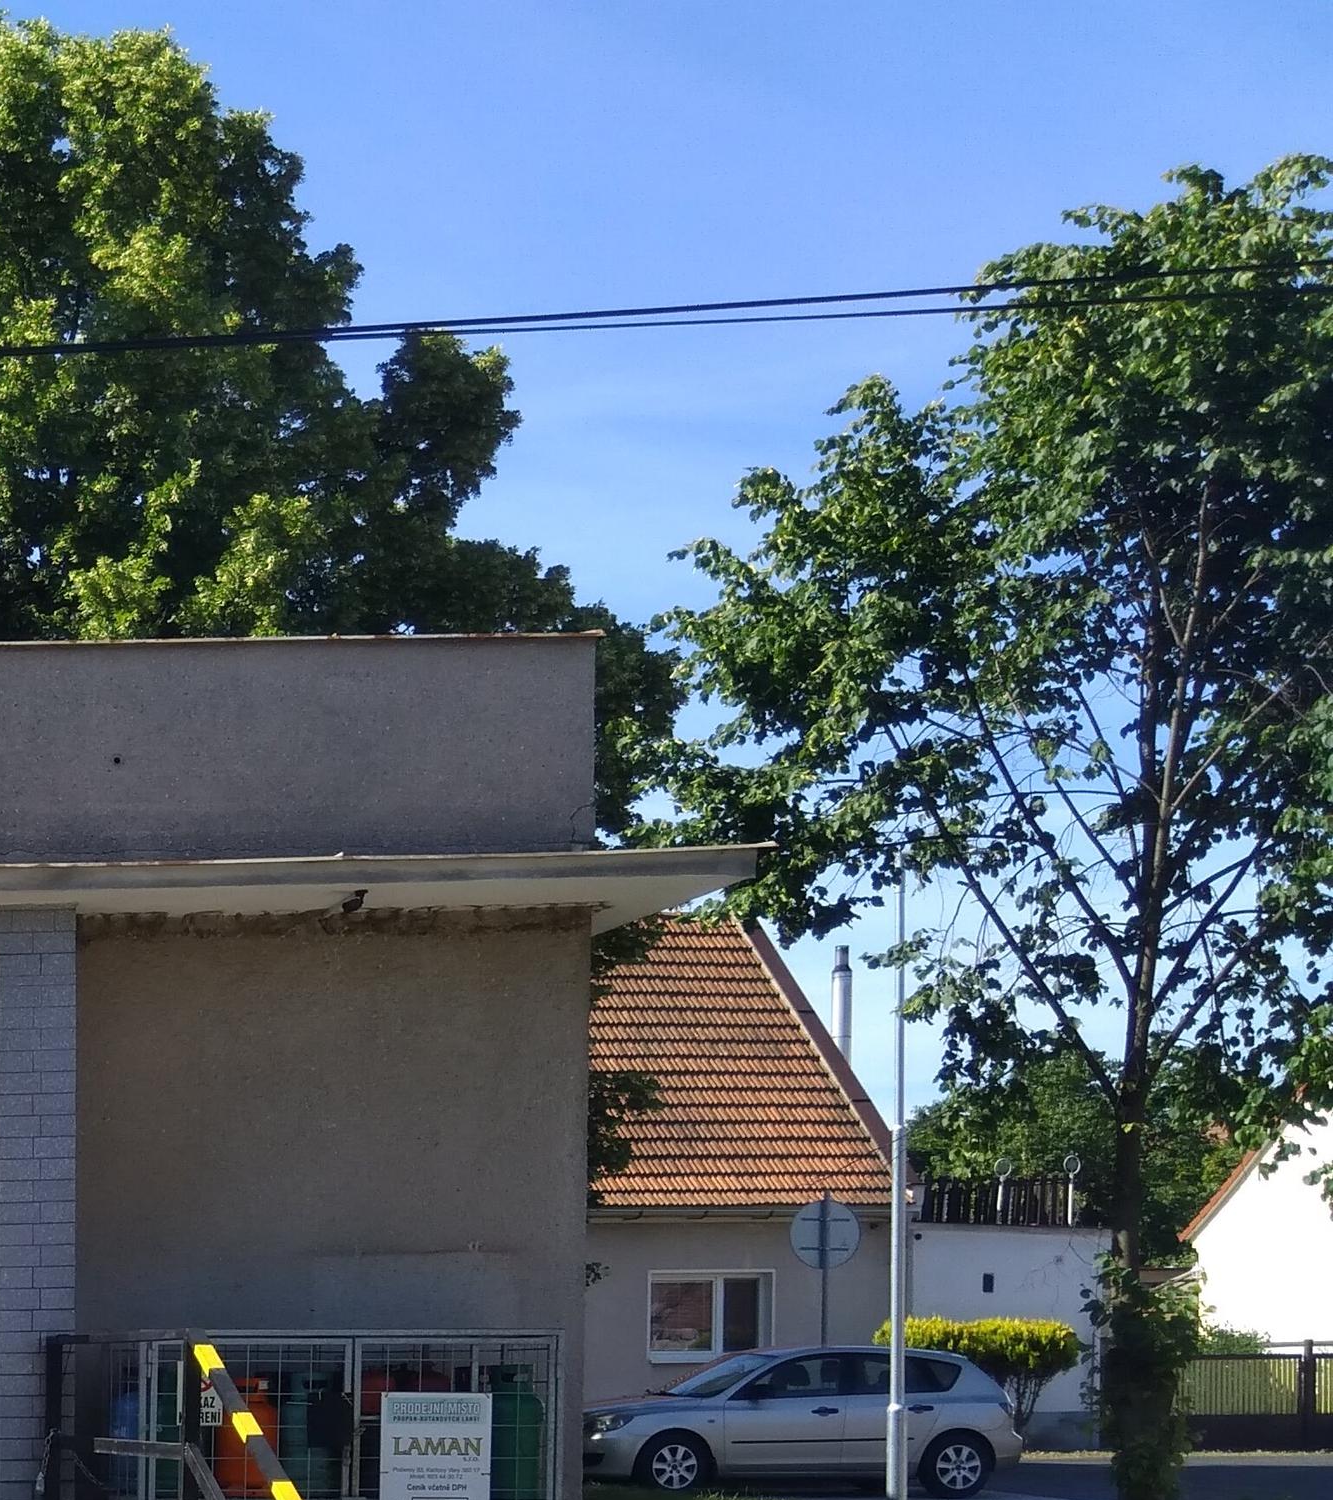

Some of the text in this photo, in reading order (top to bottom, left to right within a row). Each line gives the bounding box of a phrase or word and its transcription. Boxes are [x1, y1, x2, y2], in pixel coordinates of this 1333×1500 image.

[393, 1399, 481, 1415] PRODEJNÍ MÍSTO
[392, 1436, 484, 1457] LAMAN
[427, 1482, 450, 1492] včetně
[451, 1482, 468, 1492] DPH
